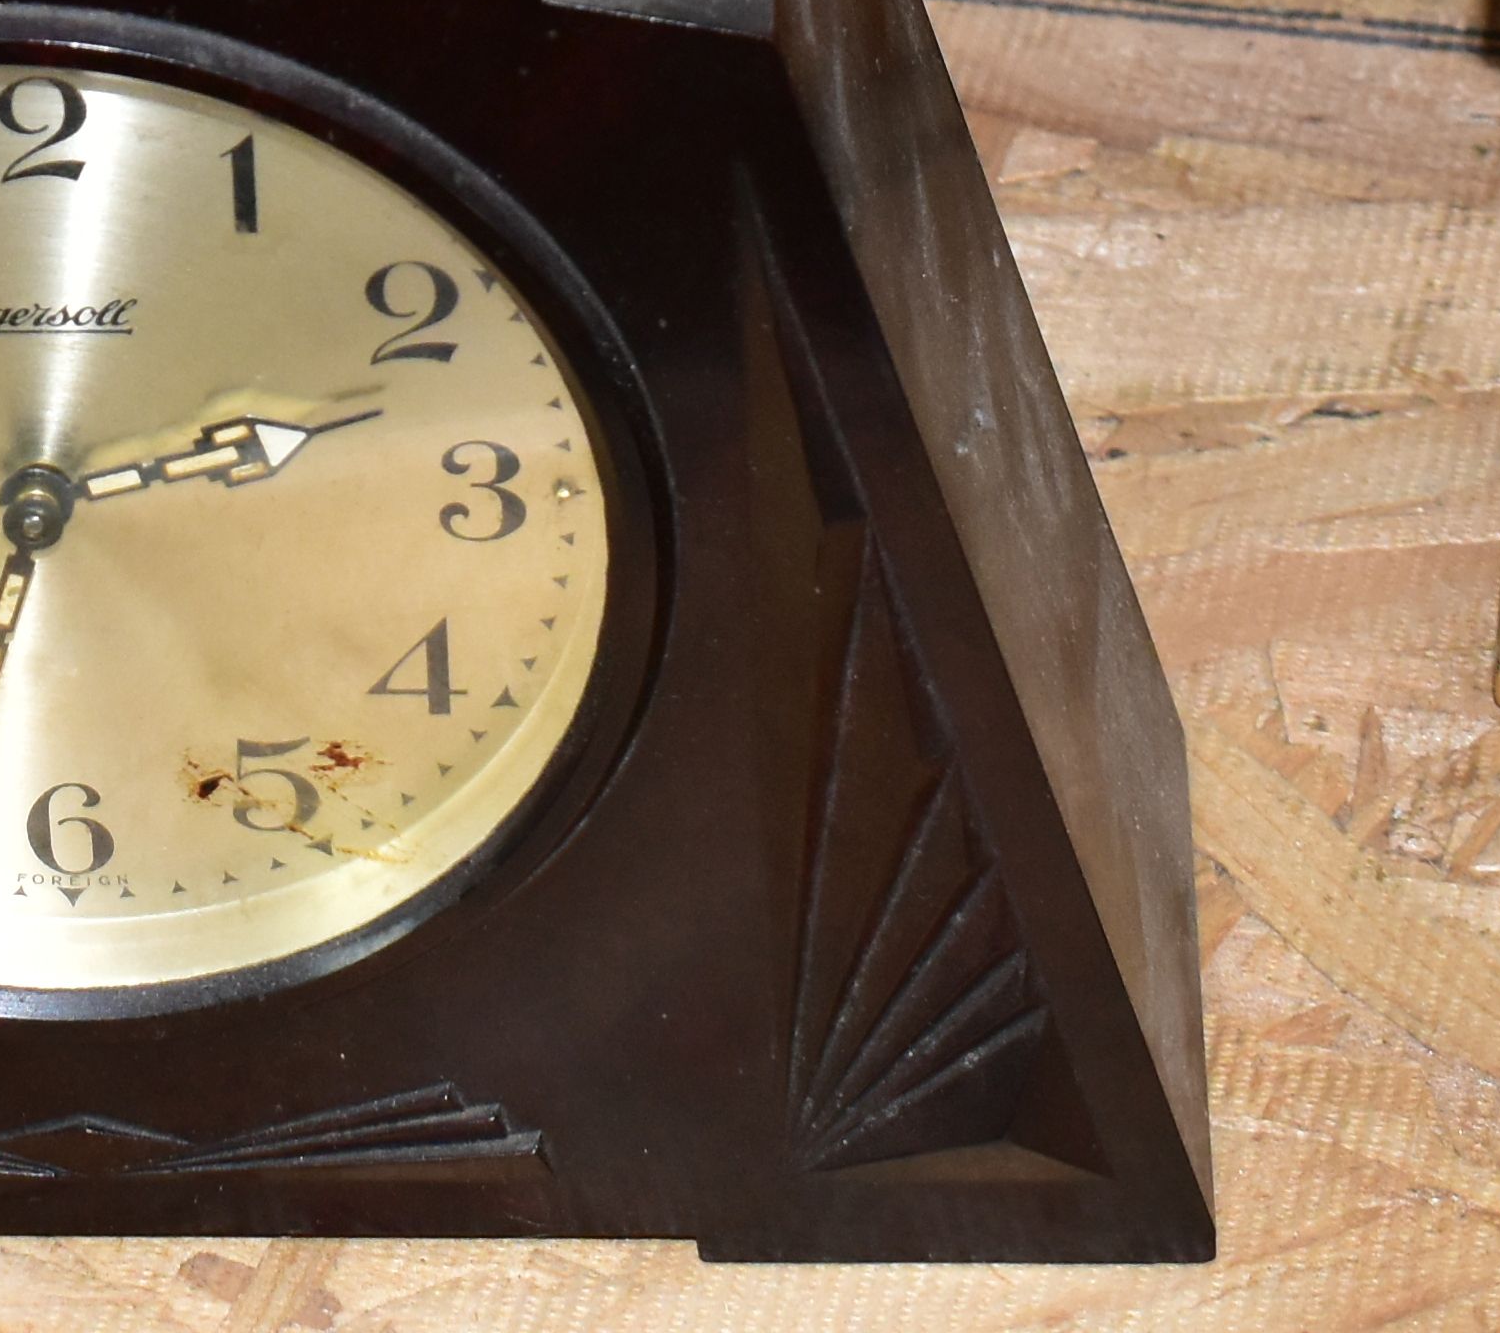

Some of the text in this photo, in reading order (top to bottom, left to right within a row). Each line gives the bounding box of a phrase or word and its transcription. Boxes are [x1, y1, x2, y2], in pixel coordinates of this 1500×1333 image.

[219, 132, 260, 235] 1
[363, 259, 461, 366] 2
[437, 439, 528, 543] 3
[365, 616, 469, 718] 4
[24, 781, 114, 877] 6
[231, 737, 321, 834] 5
[17, 873, 129, 886] FOREIGN
